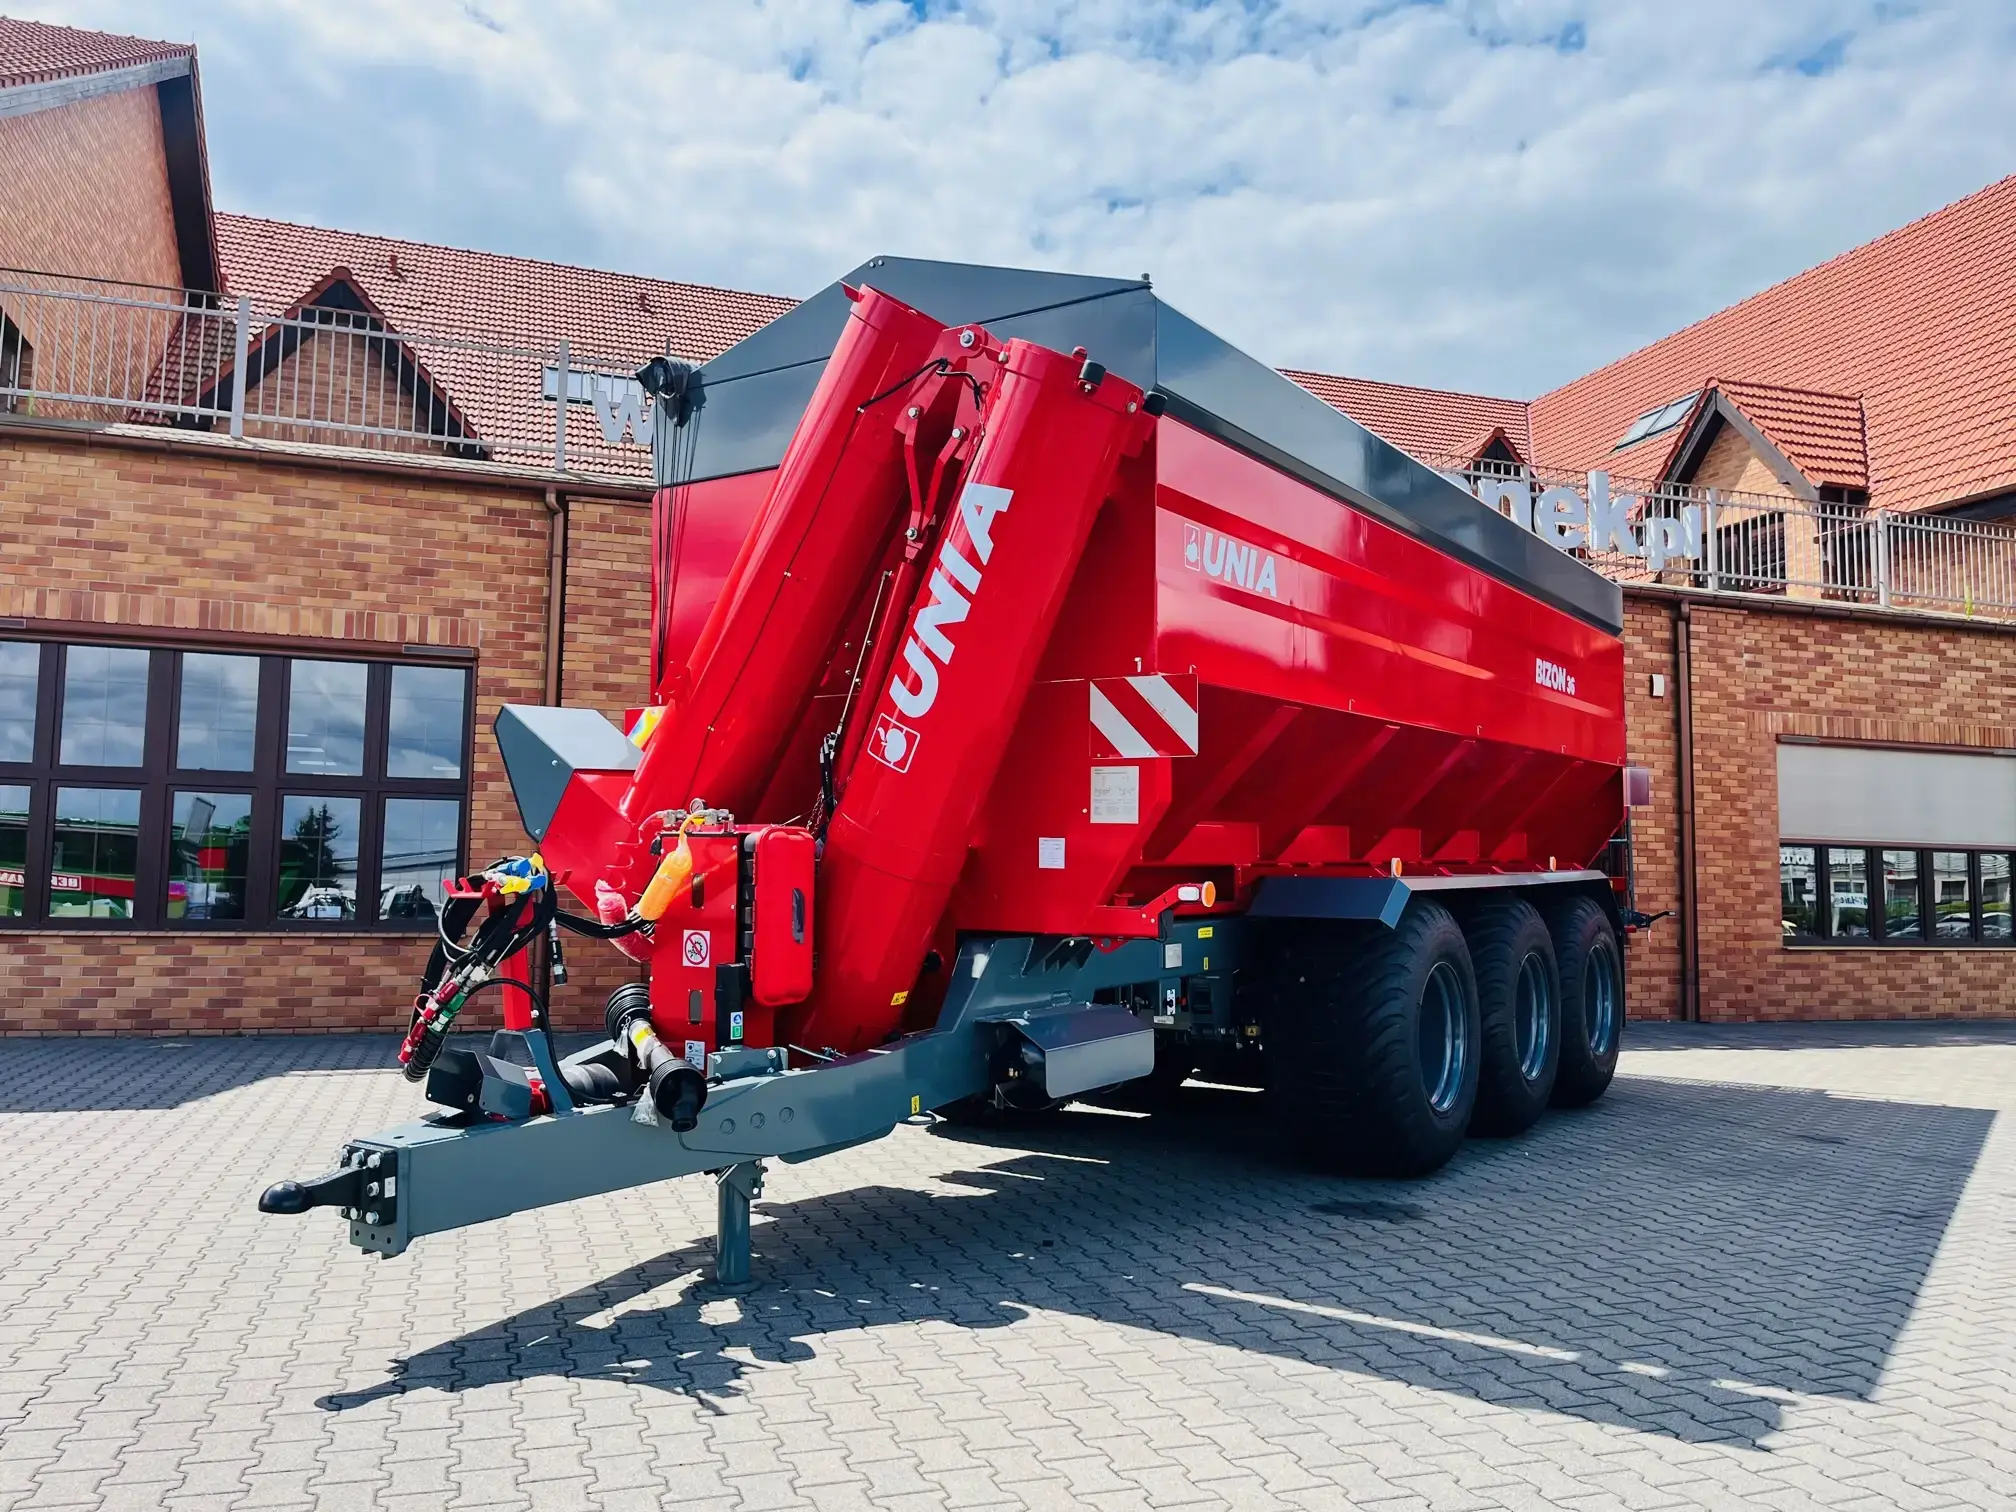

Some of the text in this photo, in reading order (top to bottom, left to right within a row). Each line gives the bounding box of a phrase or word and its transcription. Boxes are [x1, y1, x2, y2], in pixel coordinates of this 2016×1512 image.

[1443, 471, 1700, 571] nek.pl
[889, 481, 1014, 718] UNIA
[1203, 532, 1277, 598] UNIA
[1535, 657, 1576, 696] BIZON 36
